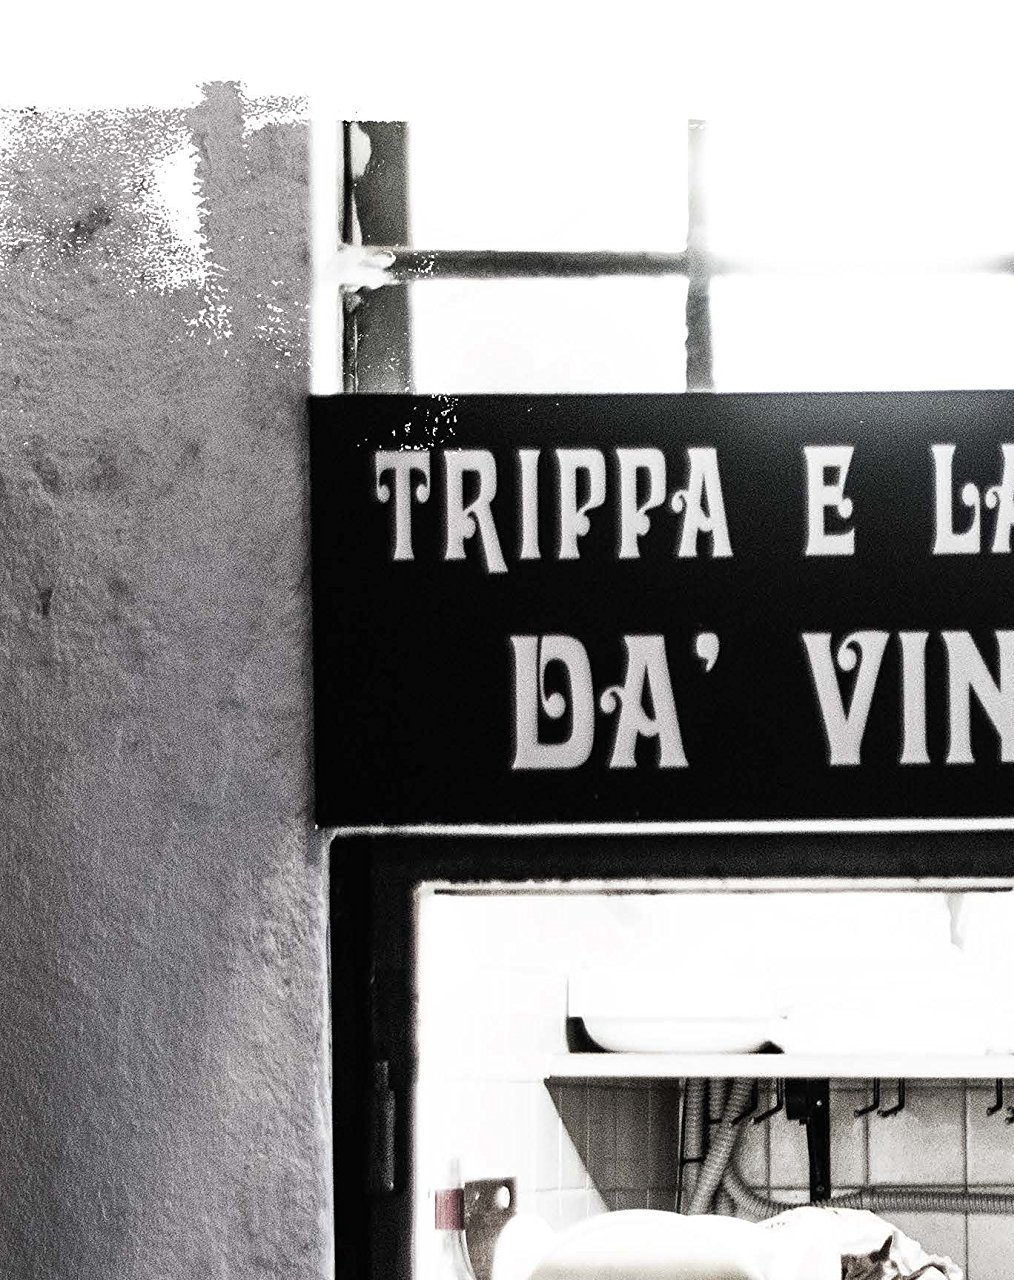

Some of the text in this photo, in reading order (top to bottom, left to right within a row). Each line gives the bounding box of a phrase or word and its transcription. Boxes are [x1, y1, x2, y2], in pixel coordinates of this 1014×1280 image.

[374, 446, 734, 574] TRIPPA
[801, 443, 857, 557] E
[510, 632, 721, 770] DA'
